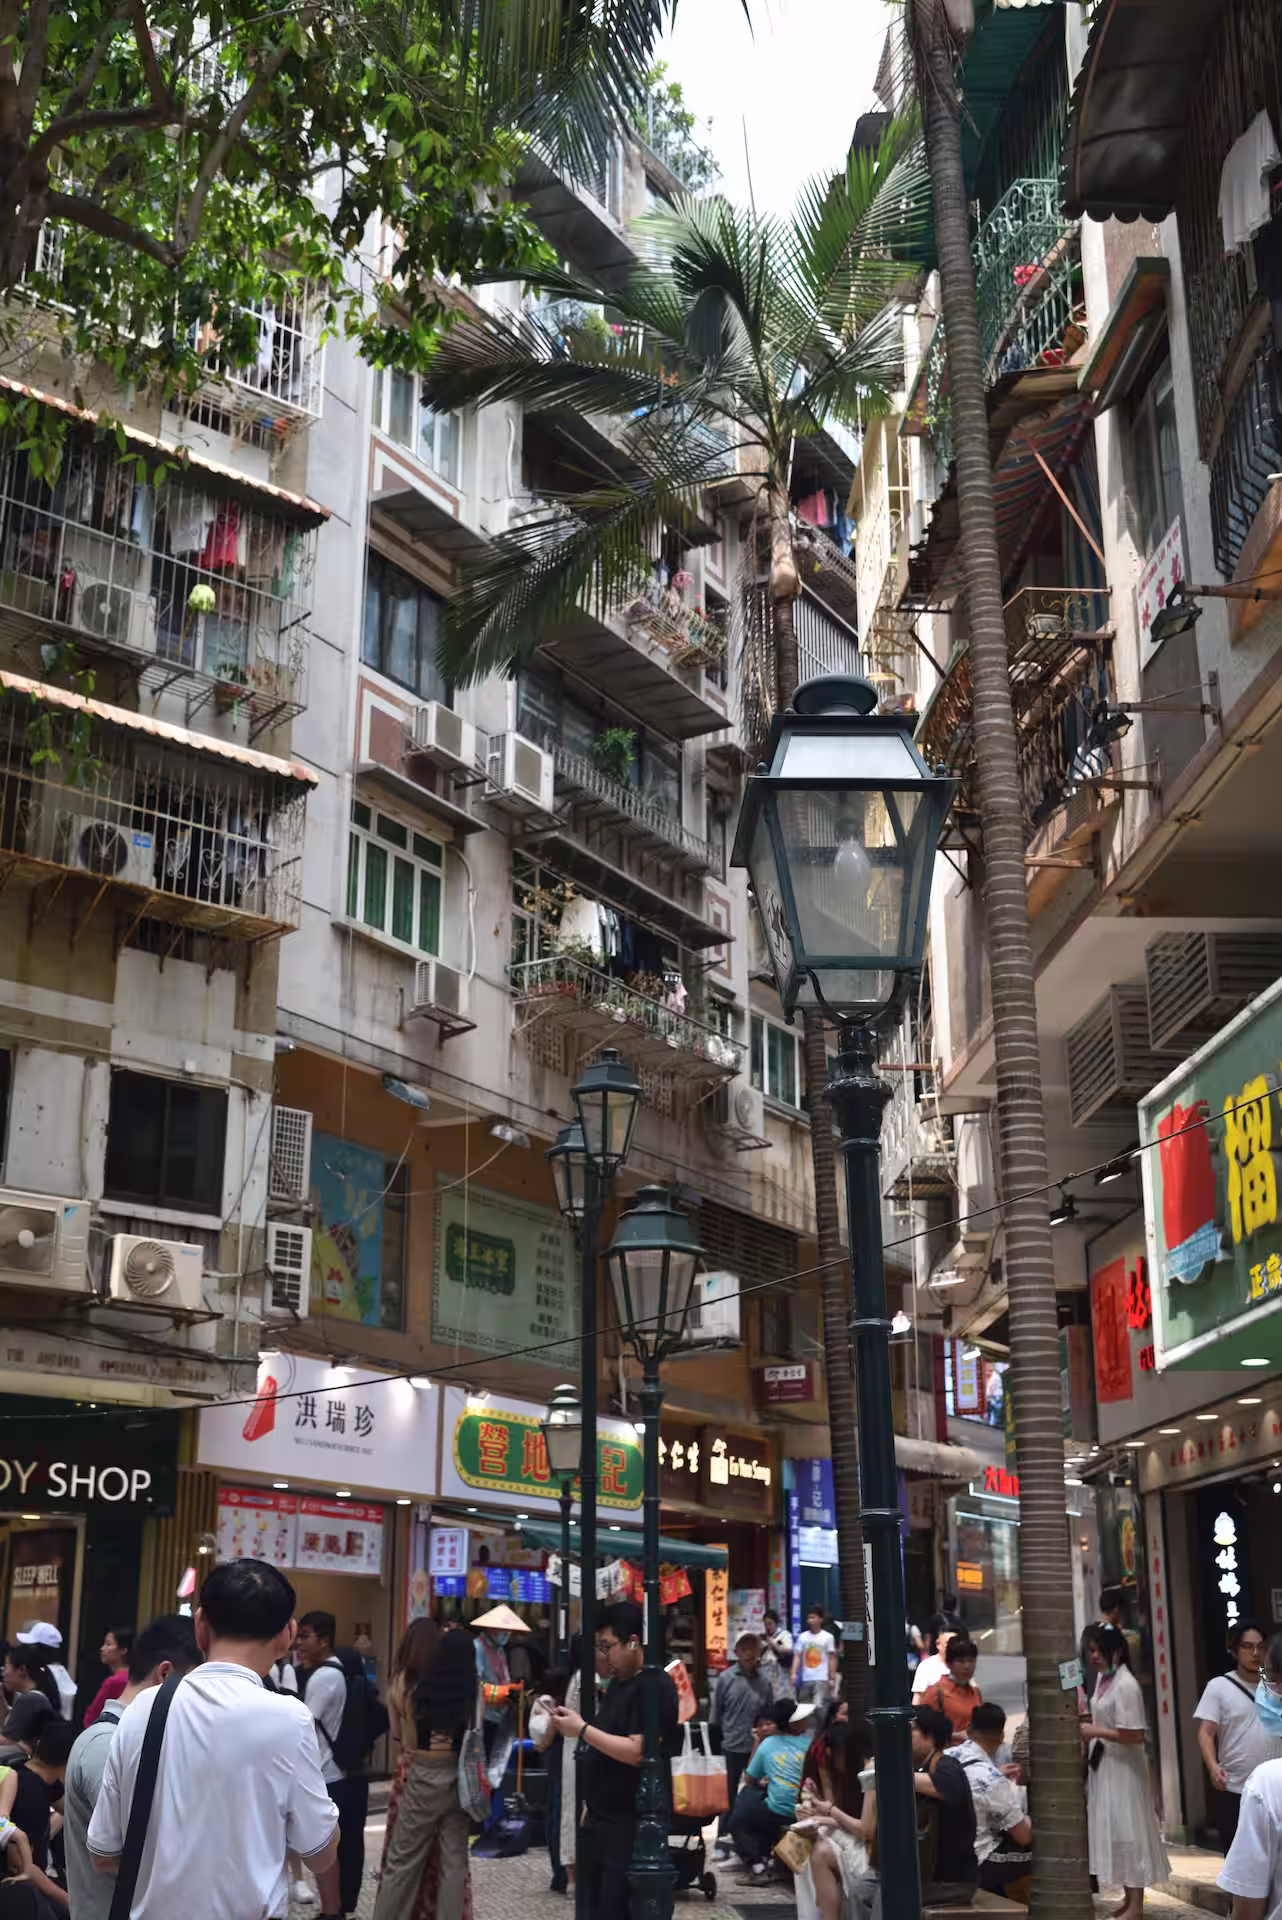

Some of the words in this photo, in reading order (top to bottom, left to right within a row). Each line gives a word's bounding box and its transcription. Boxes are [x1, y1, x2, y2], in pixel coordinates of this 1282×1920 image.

[295, 1393, 375, 1438] 洪瑞珍
[478, 1421, 628, 1496] 營地記
[14, 1566, 36, 1586] SLEEP
[37, 1564, 58, 1584] WELL
